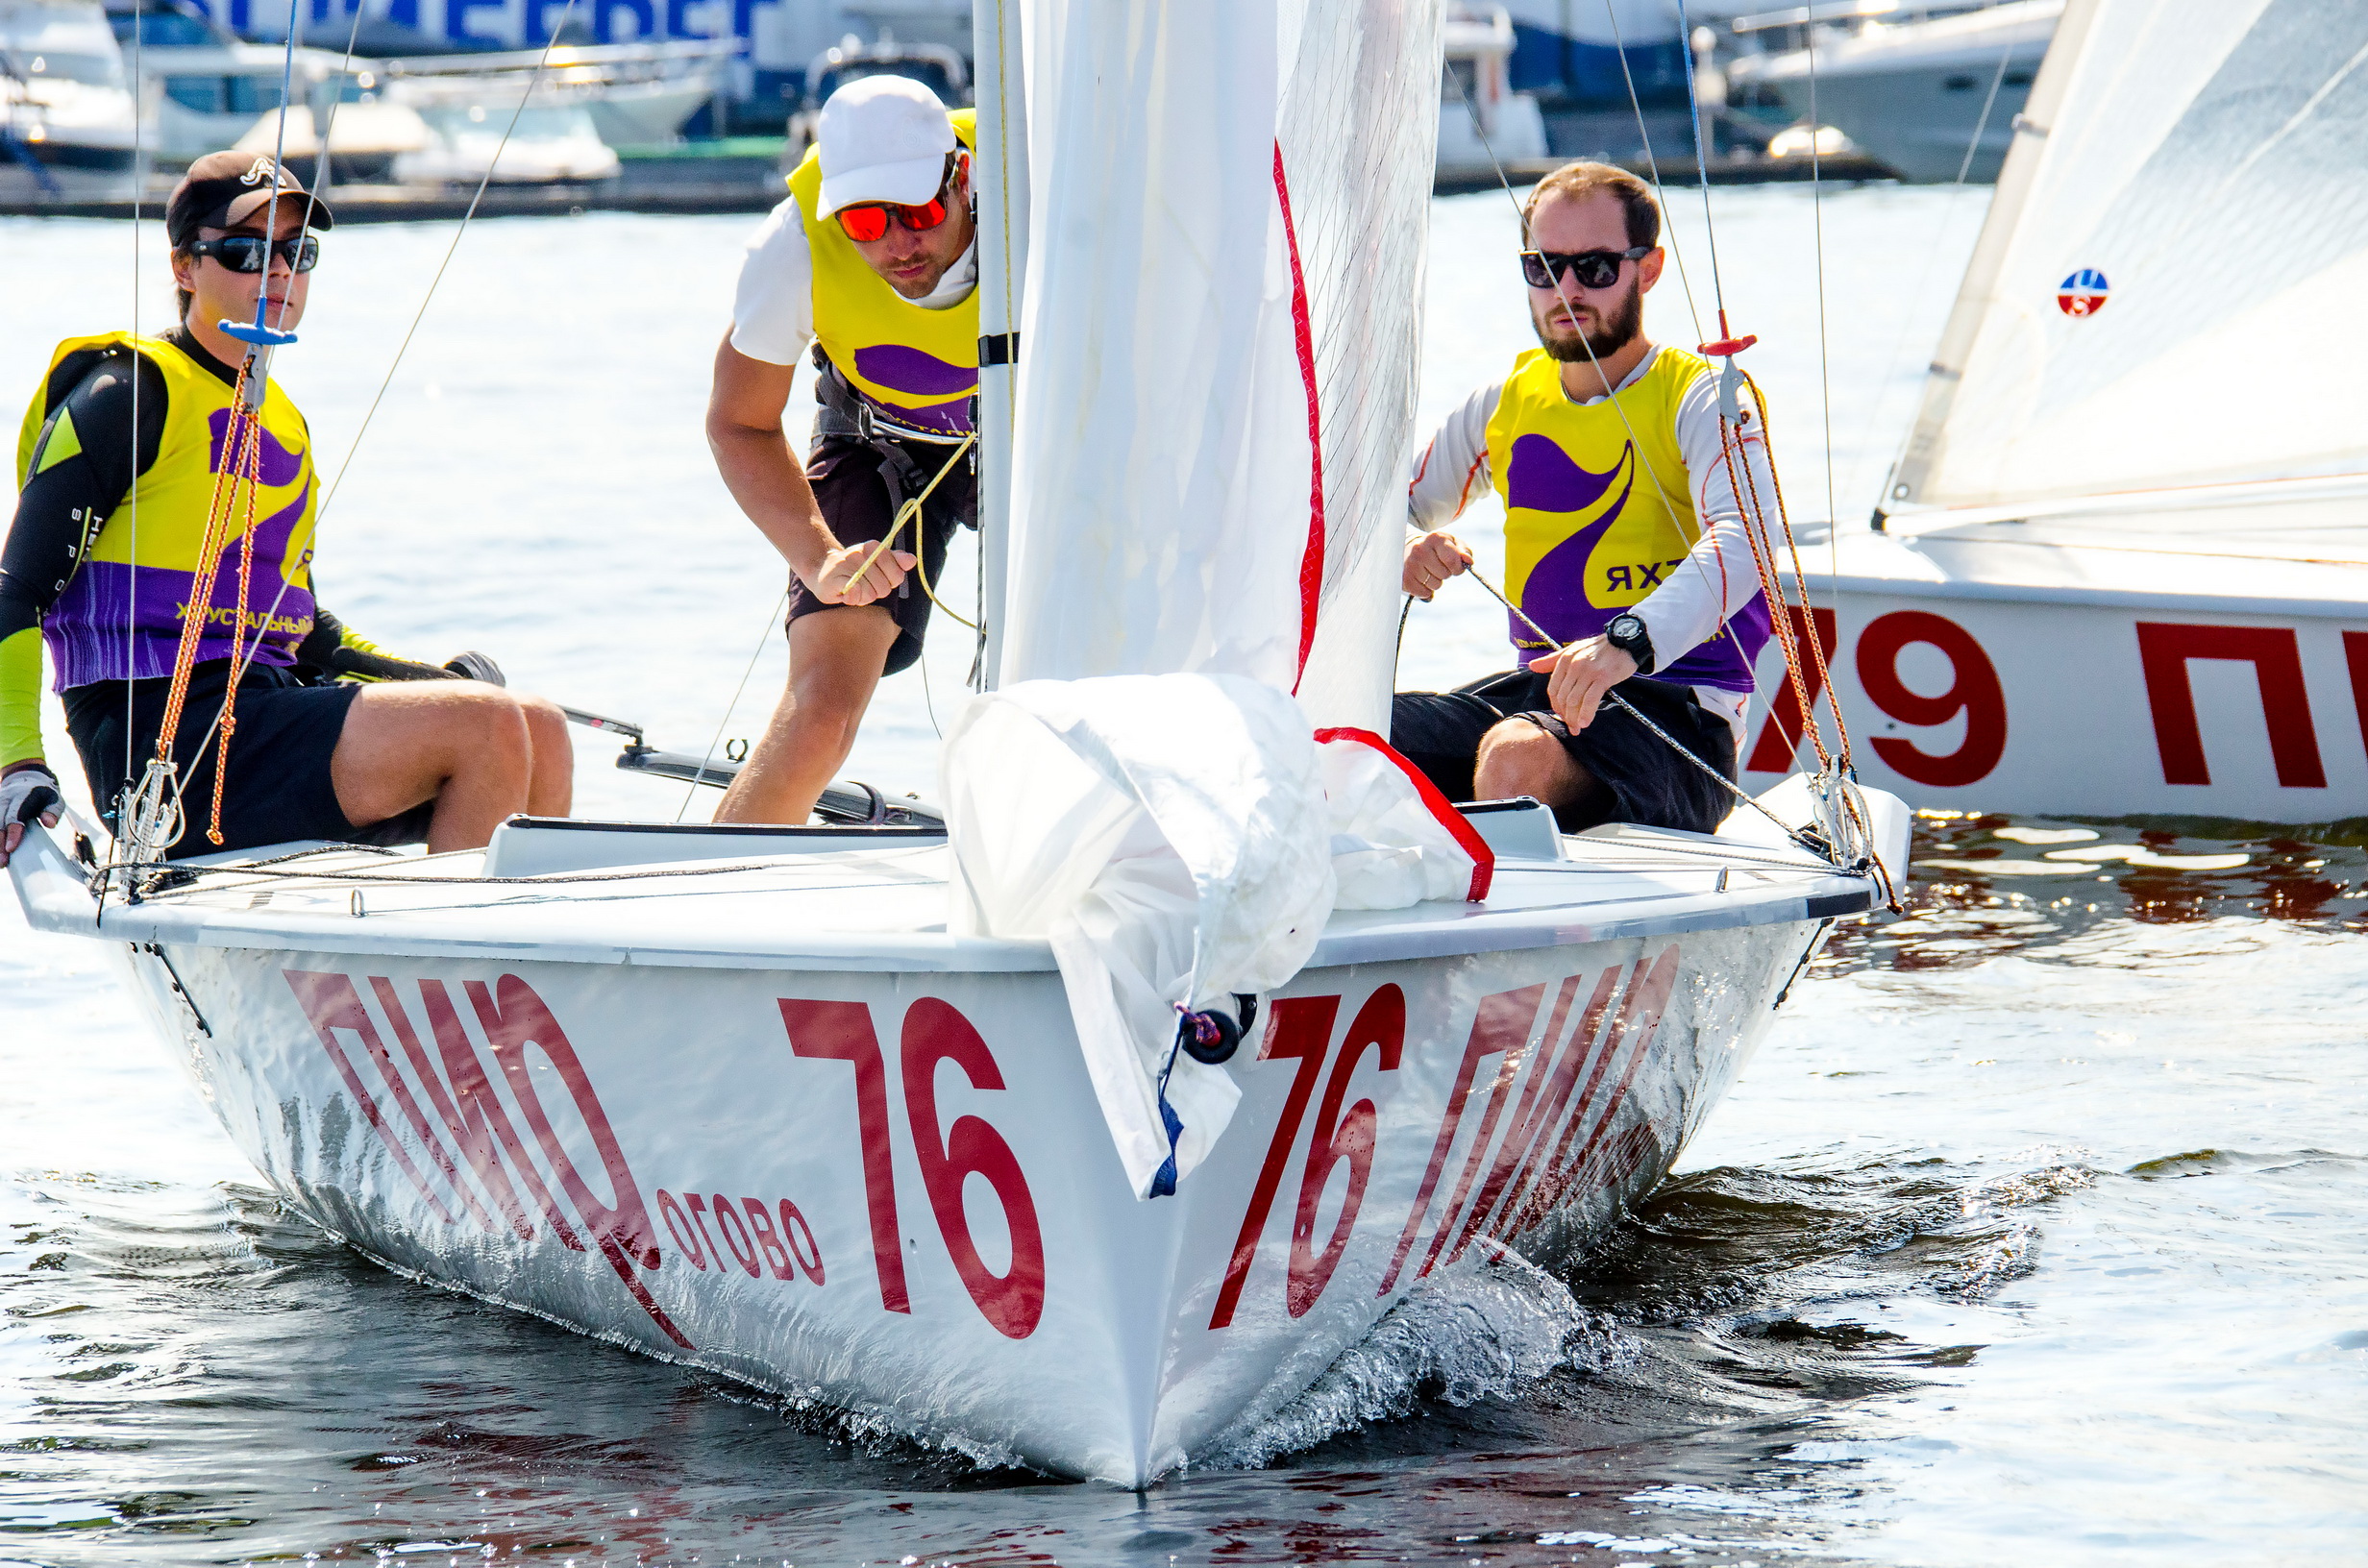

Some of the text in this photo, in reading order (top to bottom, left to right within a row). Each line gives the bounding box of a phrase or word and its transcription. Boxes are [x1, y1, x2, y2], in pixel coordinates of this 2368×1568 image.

[175, 601, 314, 635] ХУСАЛЬНЫЙ
[1606, 558, 1687, 593] ЯХ
[2135, 621, 2368, 790] П
[777, 996, 1046, 1340] 76
[1209, 982, 1407, 1331] 76
